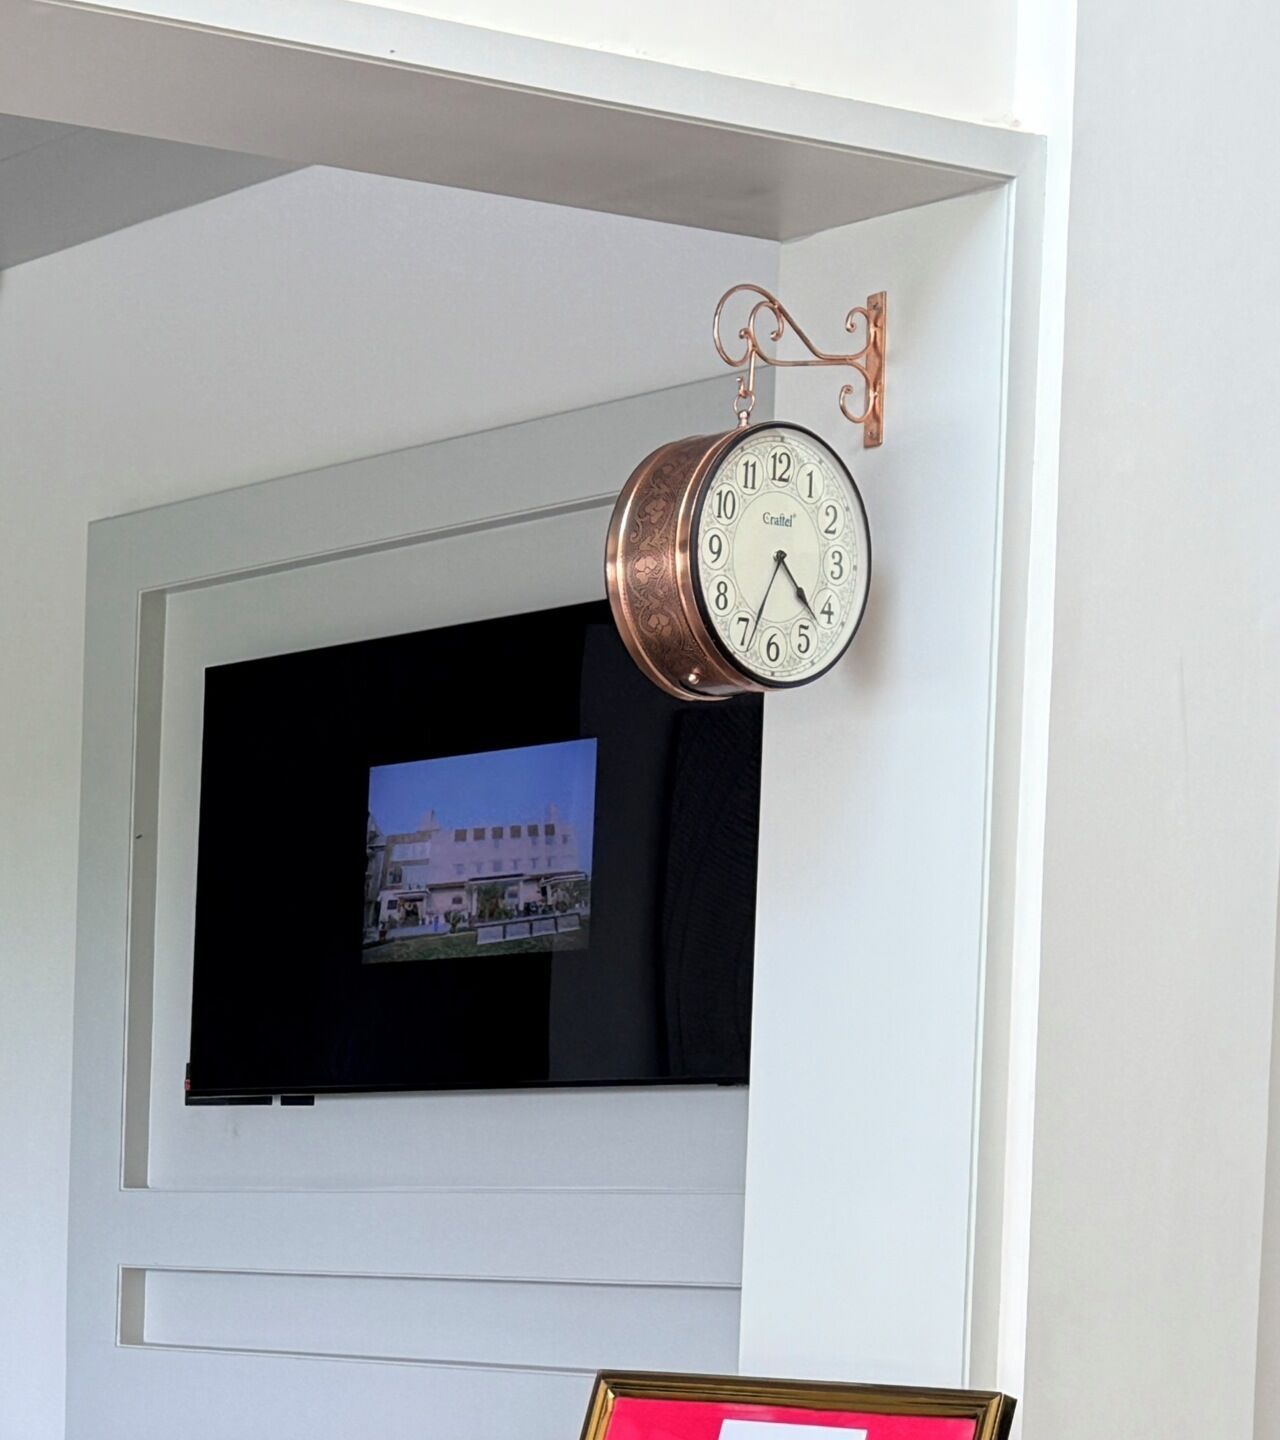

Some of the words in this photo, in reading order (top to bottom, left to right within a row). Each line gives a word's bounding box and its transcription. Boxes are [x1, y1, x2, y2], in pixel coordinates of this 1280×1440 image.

[744, 459, 757, 490] 11
[770, 452, 791, 482] 12
[807, 470, 814, 498] 1
[716, 490, 735, 520] 10
[825, 505, 838, 535] 2
[709, 534, 722, 563] 9
[830, 551, 843, 580] 3
[716, 581, 728, 611] 8
[820, 594, 834, 625] 4
[737, 617, 750, 647] 7
[797, 624, 809, 653] 5
[766, 633, 780, 662] 6
